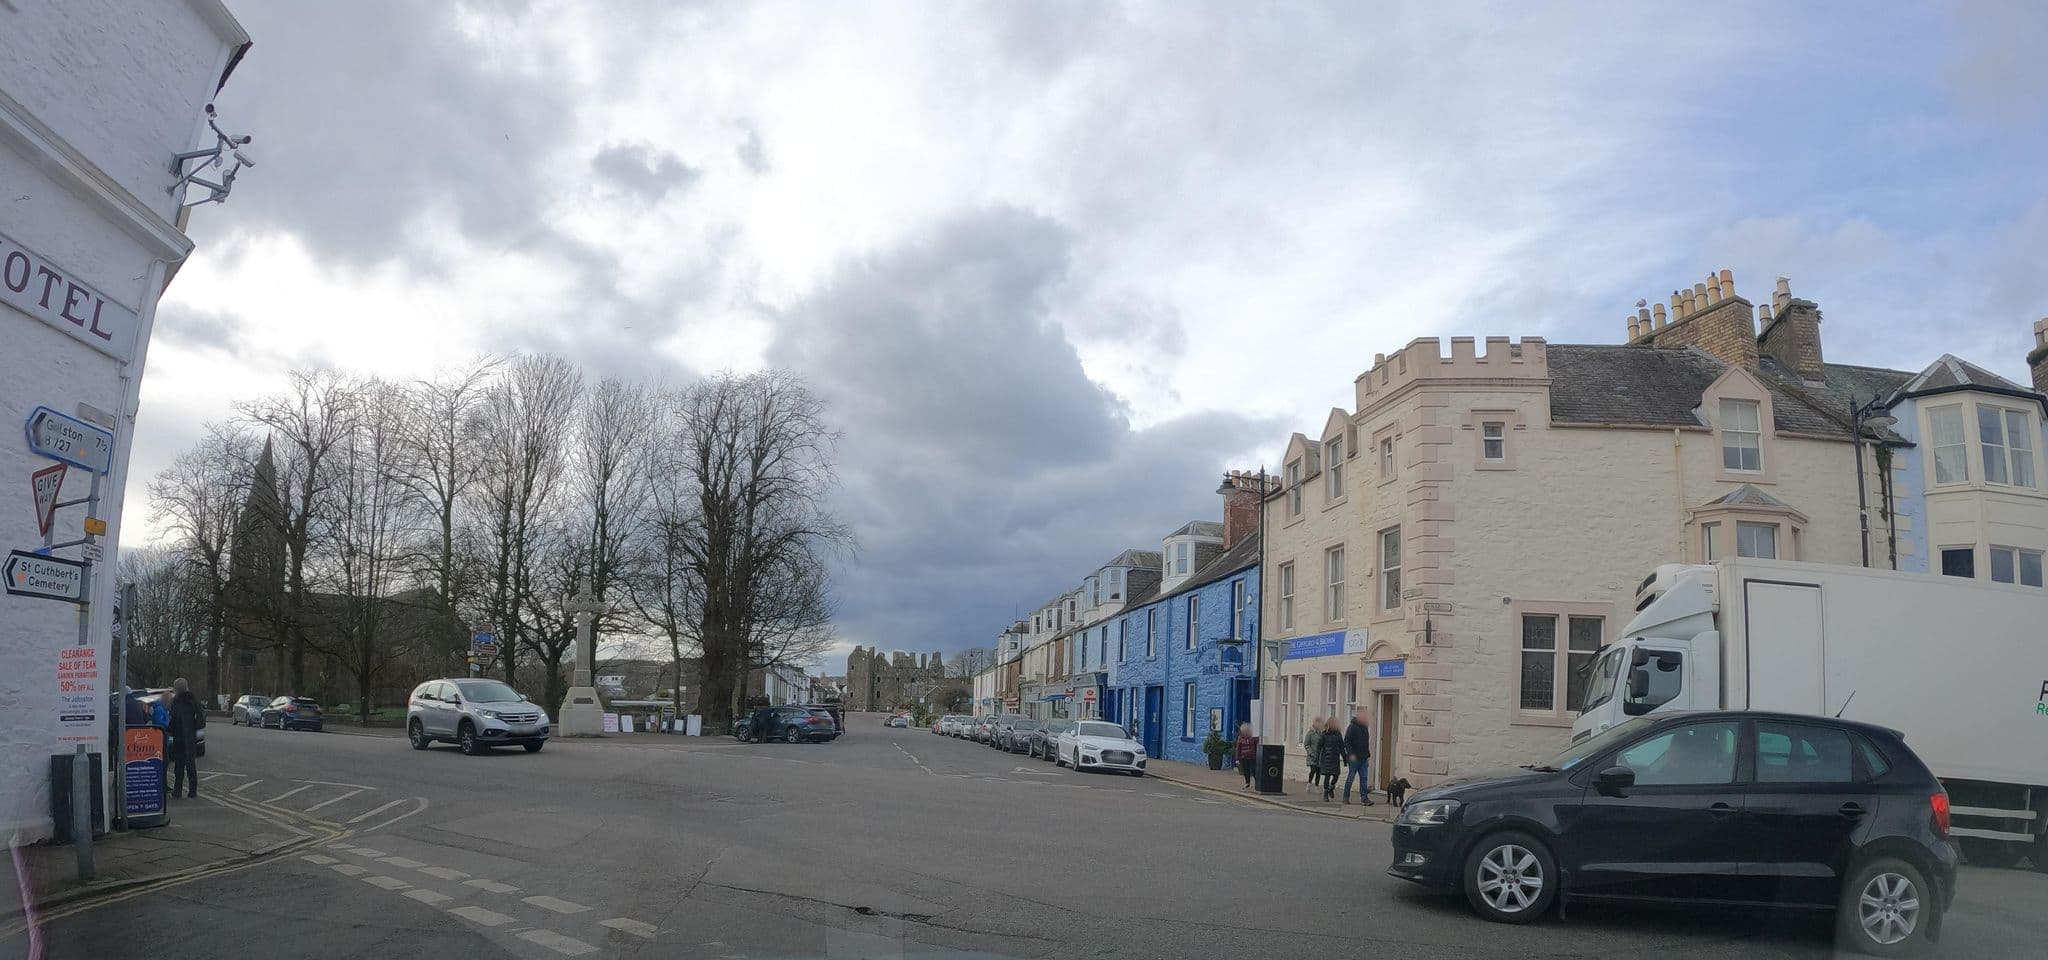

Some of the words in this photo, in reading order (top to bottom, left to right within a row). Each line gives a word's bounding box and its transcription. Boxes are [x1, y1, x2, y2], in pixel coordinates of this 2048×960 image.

[0, 240, 113, 341] OTEL
[37, 474, 58, 492] GIVE
[20, 561, 32, 572] St
[34, 563, 79, 581] Cuthbert's
[28, 575, 71, 594] Cemetery
[61, 648, 96, 659] CLEARANCE
[60, 681, 76, 692] 50%
